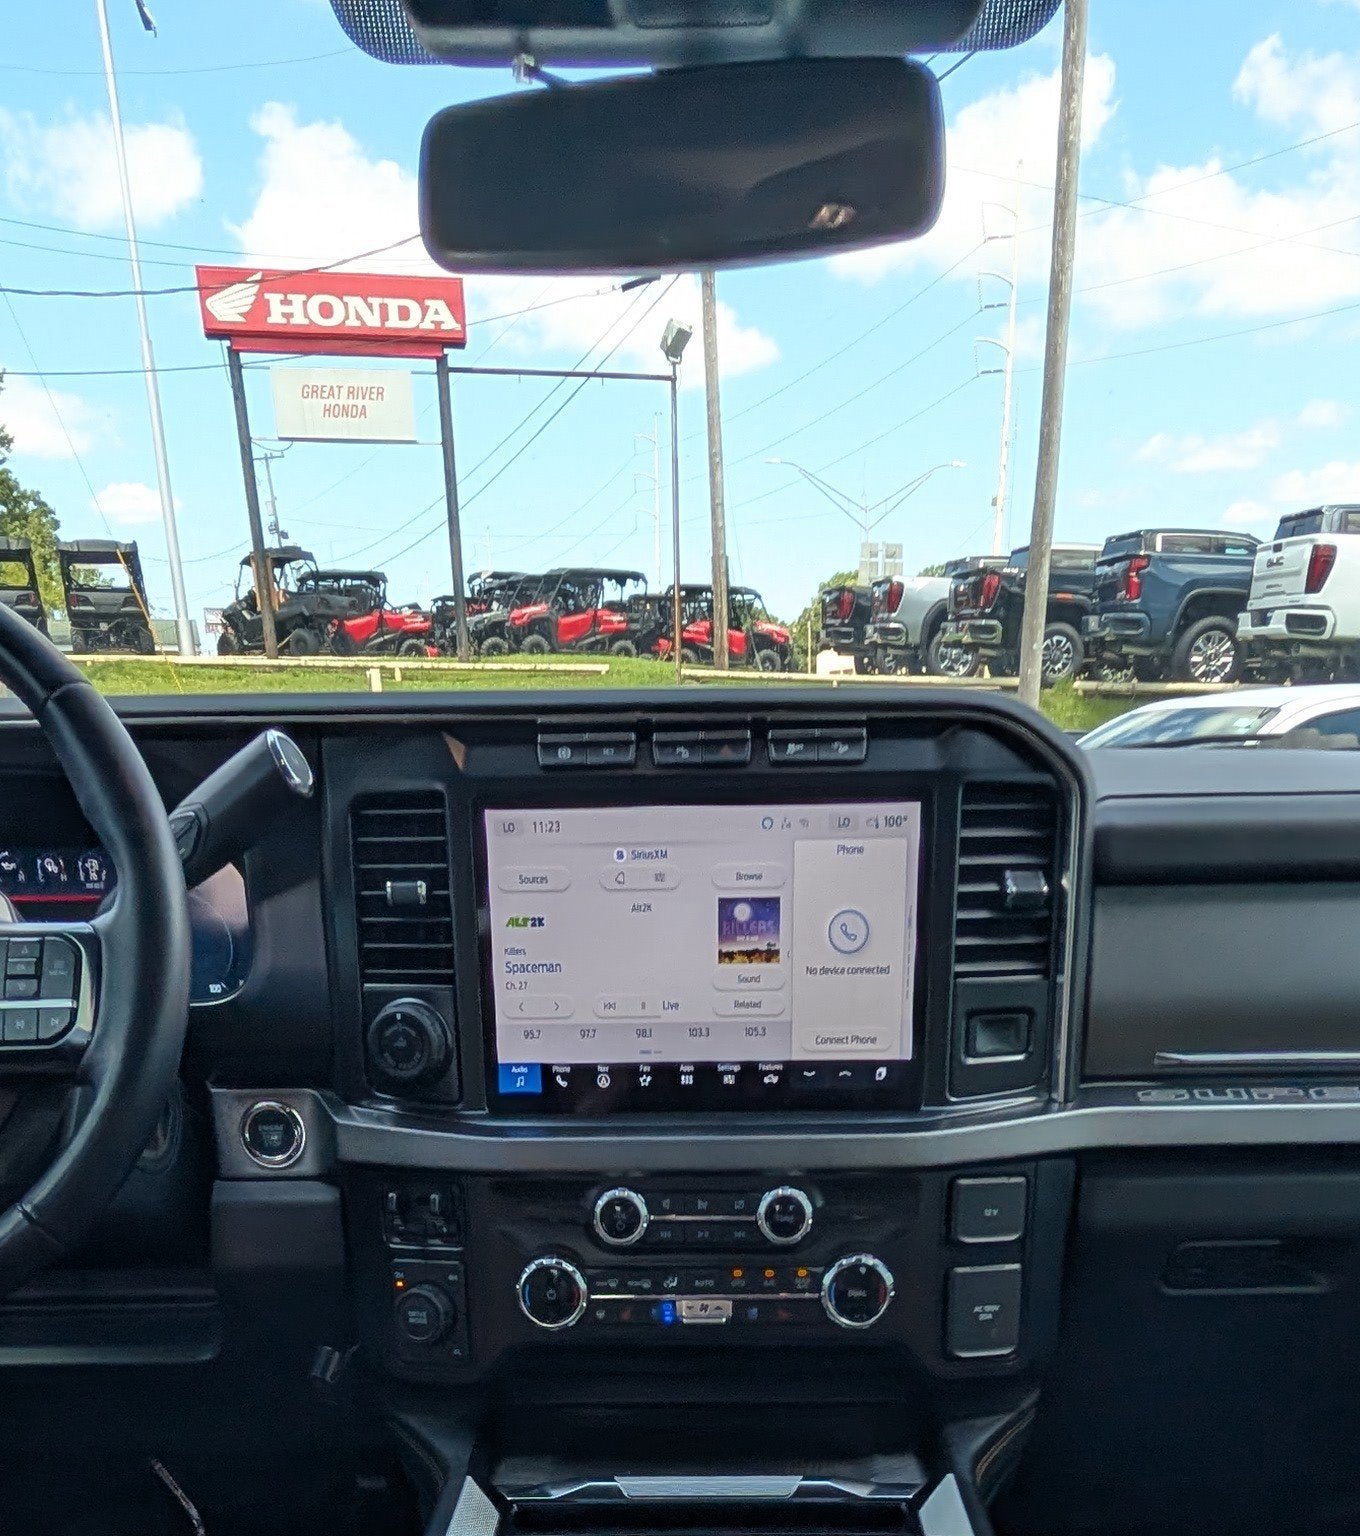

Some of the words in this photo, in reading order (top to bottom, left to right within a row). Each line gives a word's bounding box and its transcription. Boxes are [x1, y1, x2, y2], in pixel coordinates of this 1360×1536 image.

[263, 292, 462, 332] HONDA
[301, 384, 343, 401] GREAT
[347, 385, 385, 402] RIVER
[322, 403, 367, 419] HONDA
[532, 820, 561, 833] 11:23
[631, 849, 668, 860] SiriusXM
[837, 844, 864, 855] Phone
[518, 874, 548, 884] Sources
[735, 871, 763, 881] Browse
[504, 947, 527, 956] Killers
[504, 961, 562, 974] Spaceman
[805, 965, 818, 975] No
[819, 965, 845, 975] device
[846, 964, 891, 975] connected
[737, 974, 761, 984] Sound
[662, 1000, 680, 1010] Live
[733, 1001, 762, 1009] Related
[815, 1034, 849, 1045] Connect
[850, 1034, 878, 1045] Phone
